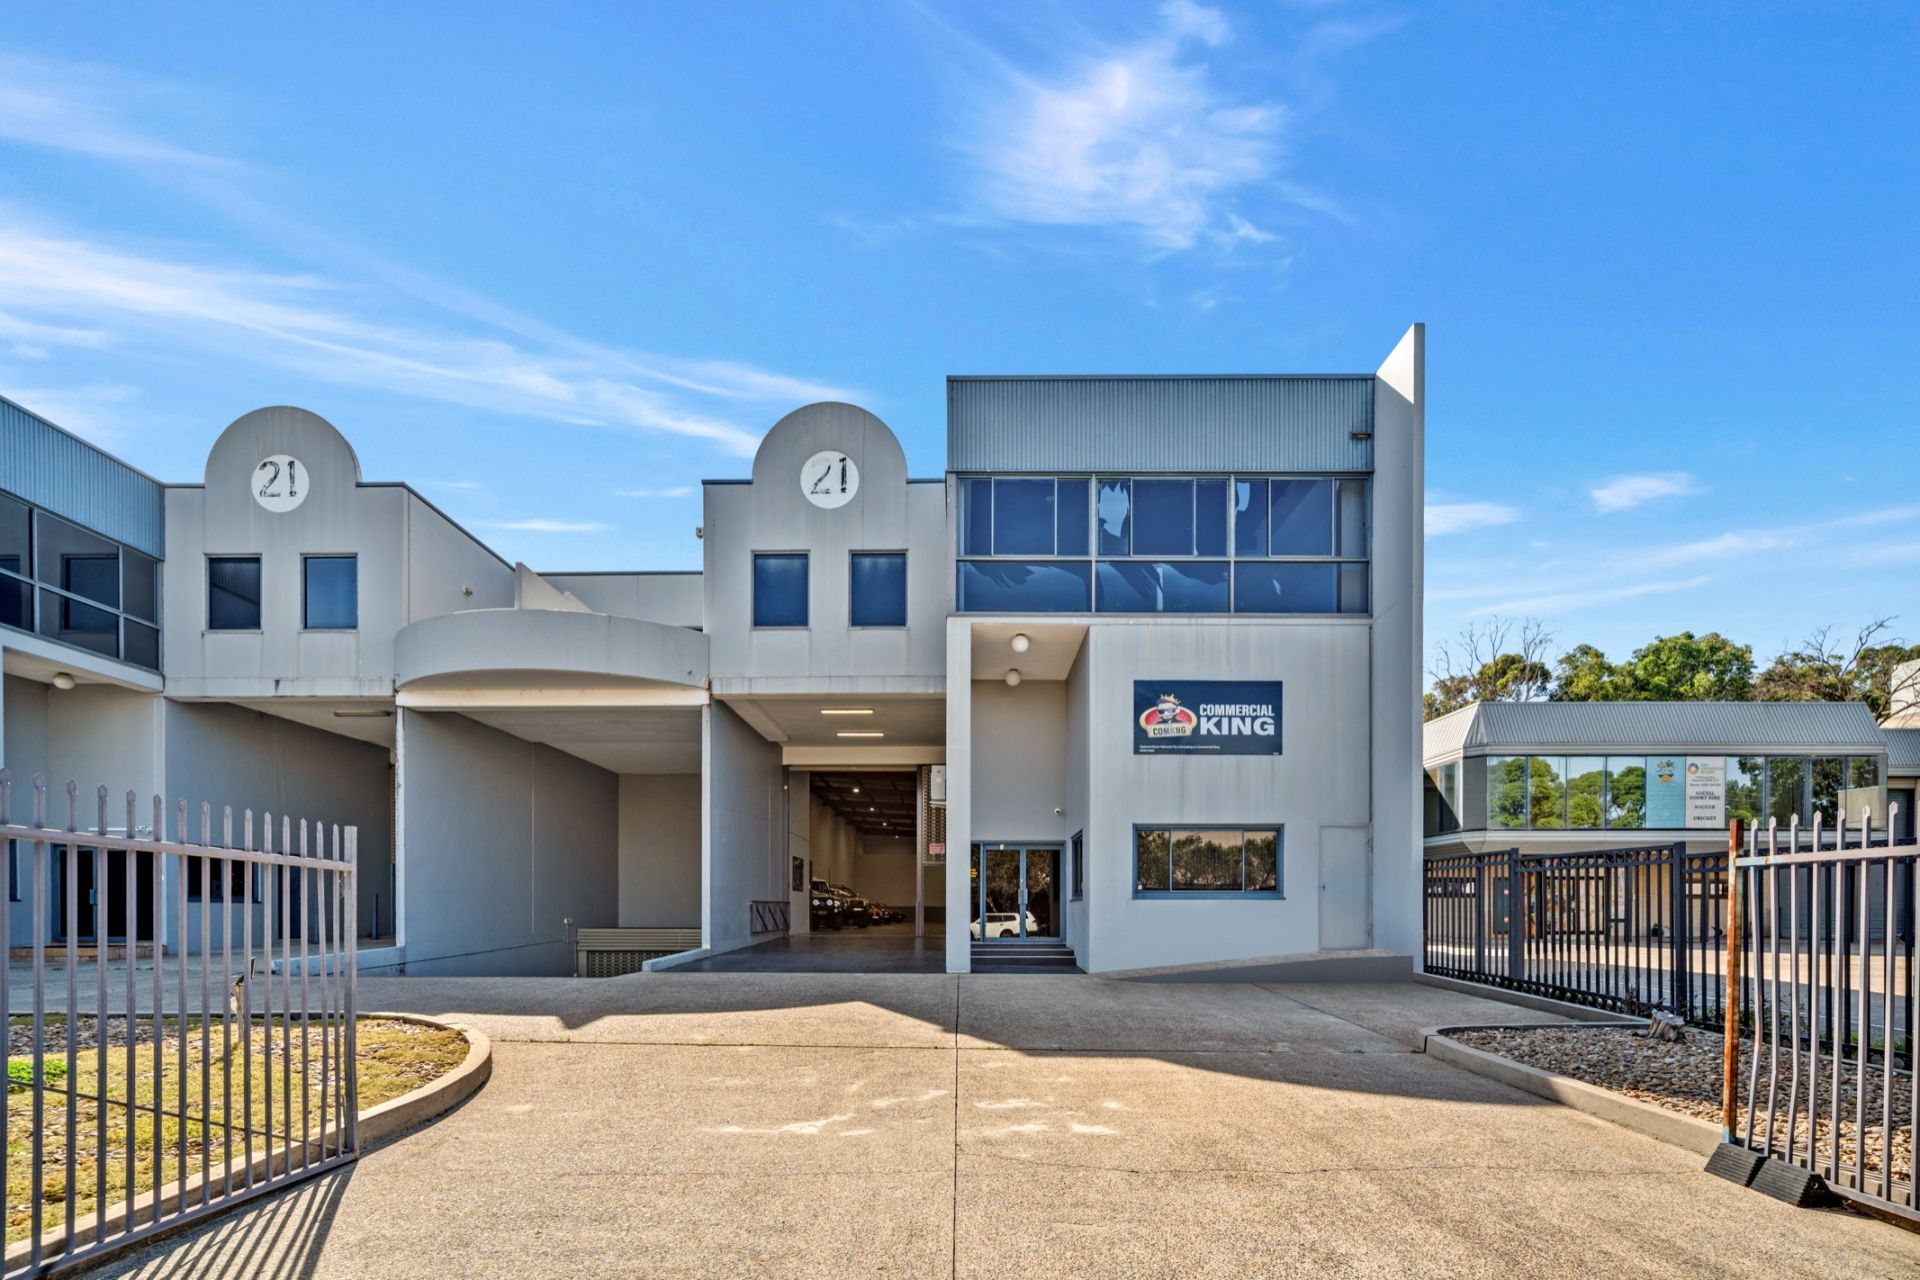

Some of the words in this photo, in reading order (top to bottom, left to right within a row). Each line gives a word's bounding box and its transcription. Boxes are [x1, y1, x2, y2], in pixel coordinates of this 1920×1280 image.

[259, 460, 297, 497] 21
[810, 457, 847, 494] 21
[1199, 704, 1275, 716] COMMERCIAL
[1200, 717, 1275, 735] KING
